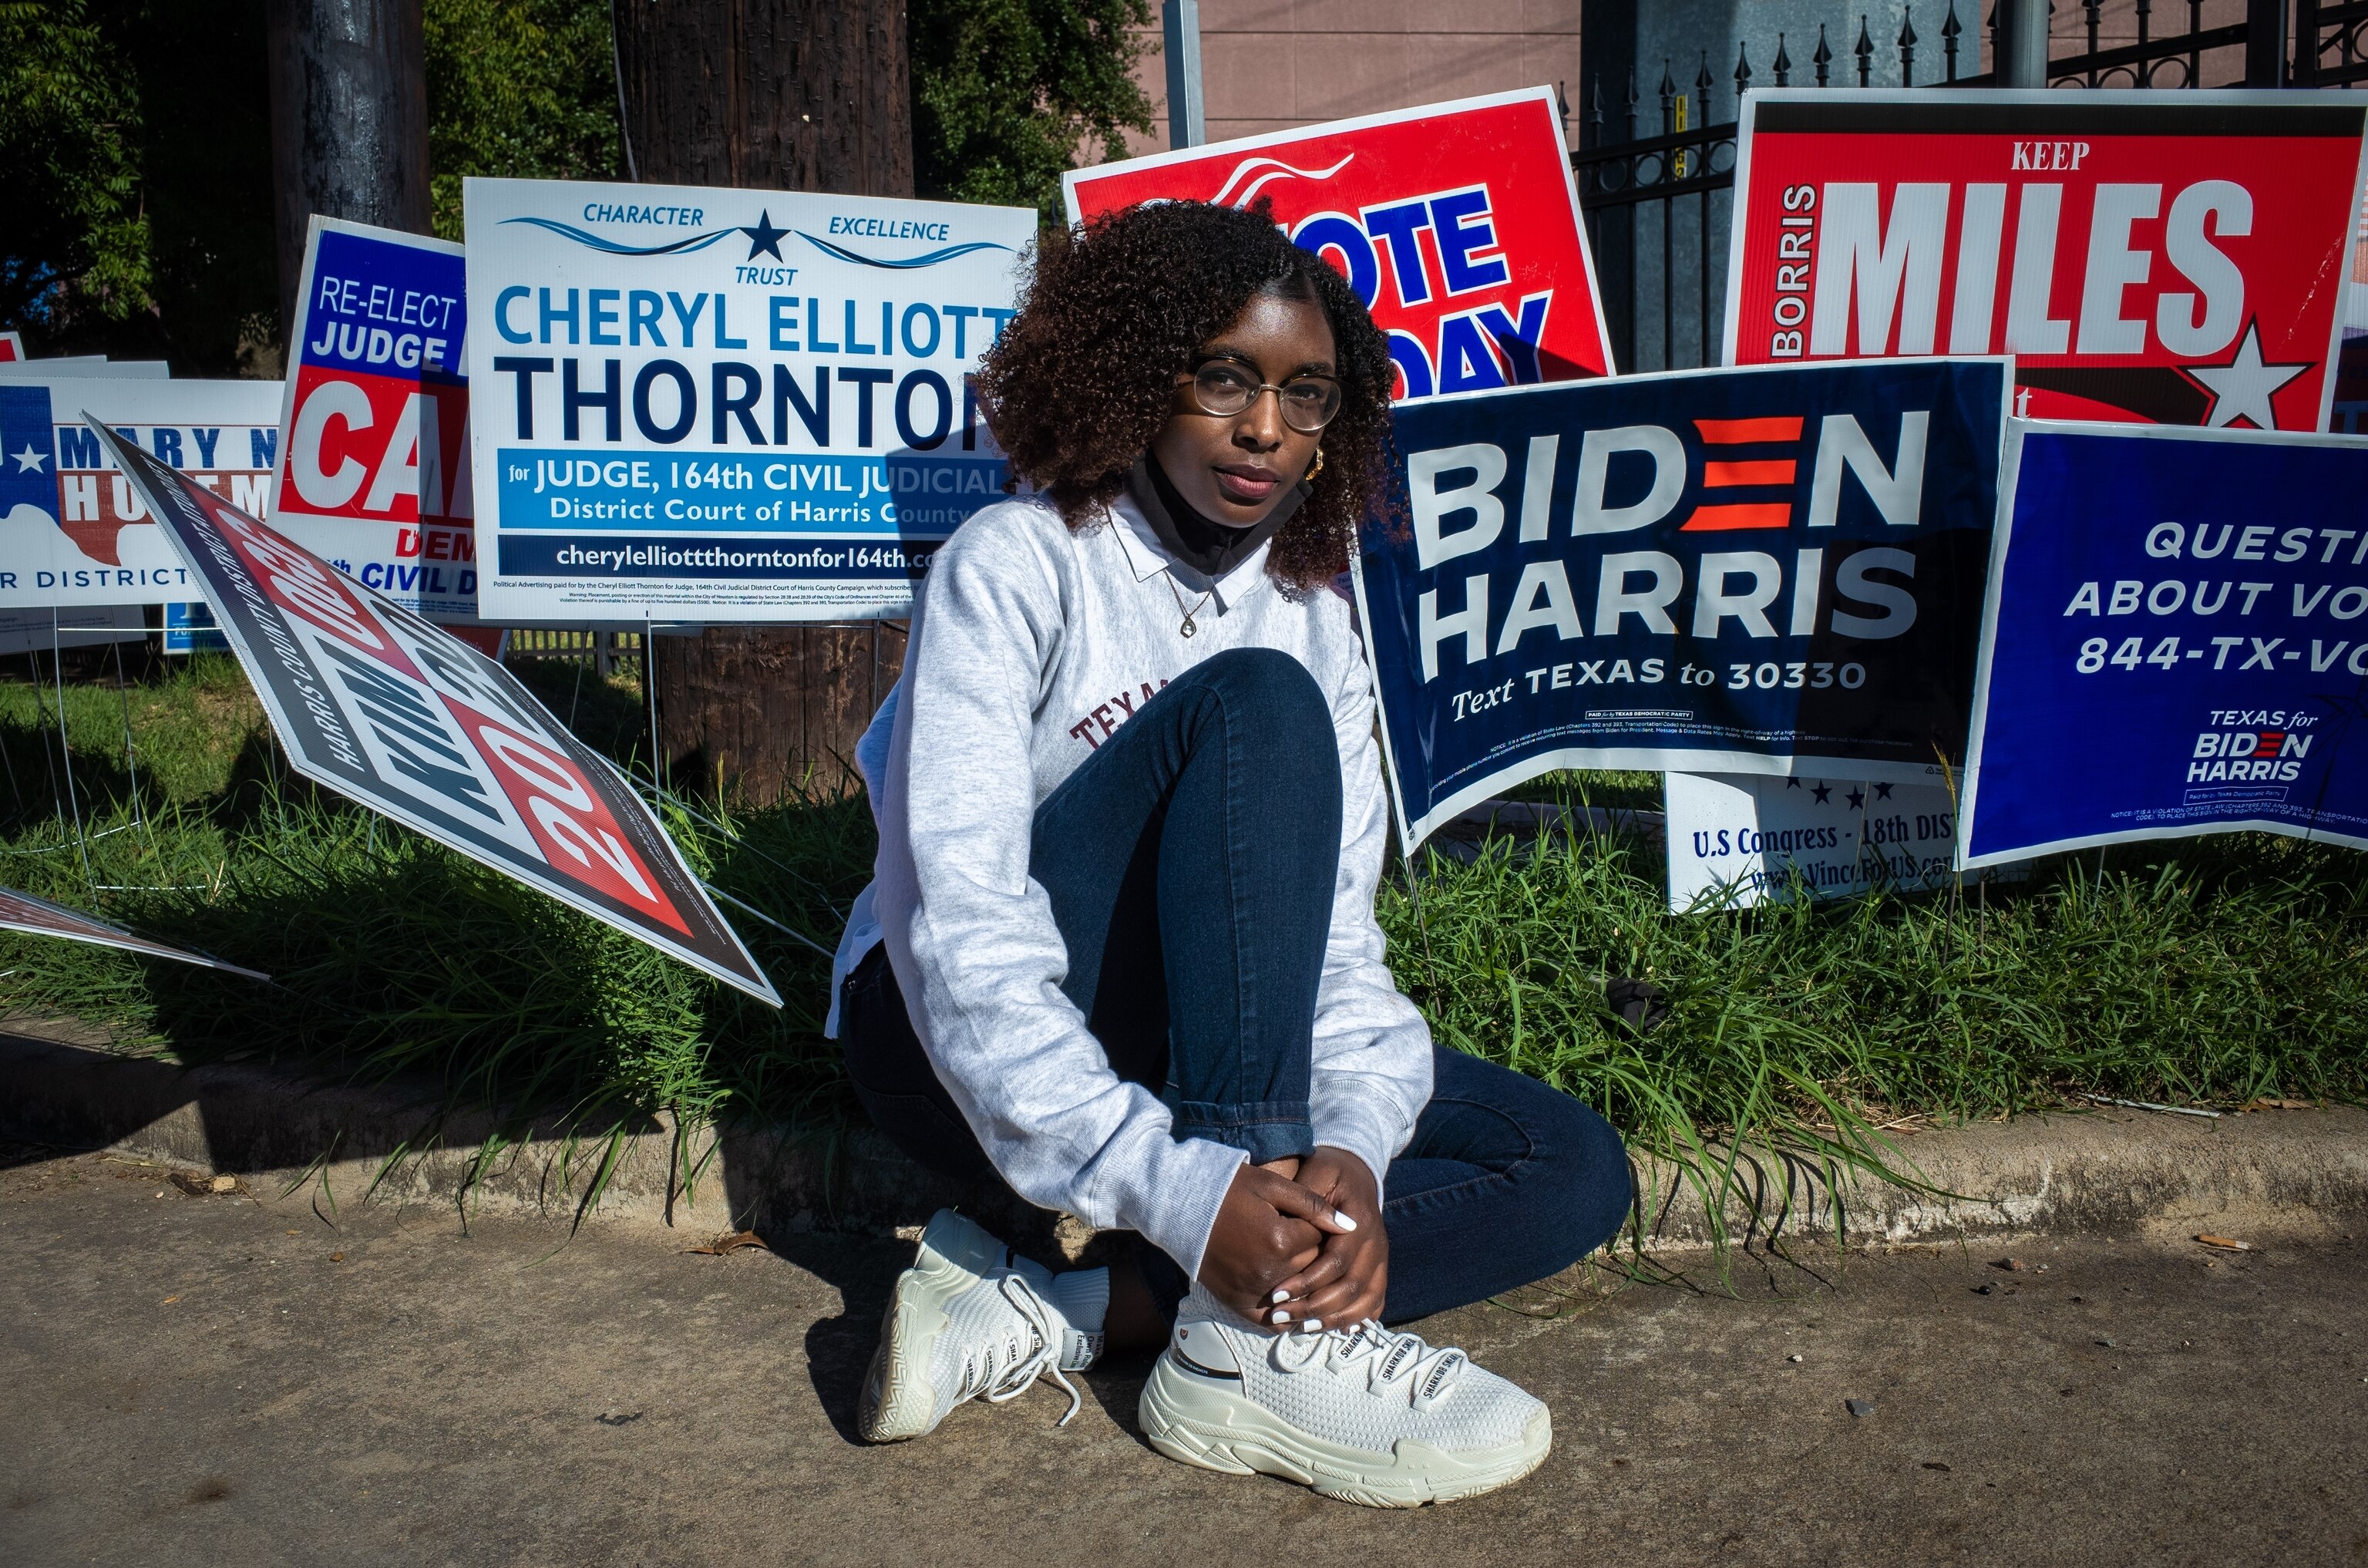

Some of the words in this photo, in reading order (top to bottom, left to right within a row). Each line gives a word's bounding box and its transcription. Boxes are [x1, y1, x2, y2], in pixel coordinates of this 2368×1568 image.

[2010, 141, 2090, 171] KEEP
[583, 204, 704, 227] CHARACTER
[829, 217, 950, 241] EXCELLENCE
[1276, 183, 1512, 312] OTE
[735, 267, 799, 287] TRUST
[1771, 182, 1818, 358] BORRIS
[1809, 180, 2254, 358] MILES
[319, 275, 457, 330] RE-ELECT
[494, 285, 748, 351] CHERYL
[311, 321, 447, 372] JUDGE
[59, 427, 220, 469] MRY
[251, 428, 278, 469] N
[291, 380, 473, 517] CA
[509, 464, 530, 483] for
[534, 459, 660, 494] JUDGE,
[671, 462, 754, 490] 164th
[763, 463, 853, 492] CIVIL
[859, 466, 1005, 499] JUDICIAL
[1407, 409, 1930, 572] BIDEN
[550, 497, 655, 520] District
[664, 499, 746, 521] Court
[755, 500, 783, 522] of
[791, 500, 871, 523] Harris
[880, 503, 970, 526] County
[191, 523, 265, 604] DISTRICT
[395, 528, 476, 562] DEM
[557, 544, 934, 571] cherylelliottthorntonfor164th.co
[2145, 522, 2368, 565] QUESTI
[0, 572, 18, 589] R
[37, 568, 187, 588] DISTRICT
[216, 509, 384, 650] OGG
[361, 562, 448, 595] CIVIL
[457, 570, 477, 595] D
[518, 581, 553, 590] Advertising
[1418, 547, 1918, 685] HARRIS
[2064, 580, 2273, 617] ABOUT
[2292, 584, 2368, 620] VO
[242, 597, 313, 680] COUNTY
[2076, 637, 2368, 676] 844-TX-VO
[1451, 678, 1515, 722] Text
[1524, 658, 1665, 695] TEXAS
[1680, 661, 1716, 687] to
[1727, 661, 1866, 689] 30330
[293, 679, 364, 771] HARRIS
[313, 635, 506, 825] KIM
[2210, 711, 2286, 726] TEXAS
[2284, 710, 2319, 732] for
[2193, 732, 2313, 759] BIDEN
[2187, 761, 2301, 782] HARRIS
[1693, 829, 1730, 858] U.S
[1737, 826, 1838, 859] Congress
[1916, 813, 1958, 840] DIS
[2306, 808, 2368, 824] TRANSPORTATIO
[1073, 1334, 1085, 1361] Exclusive
[1085, 1336, 1095, 1353] Own
[1402, 1338, 1418, 1351] SNEA
